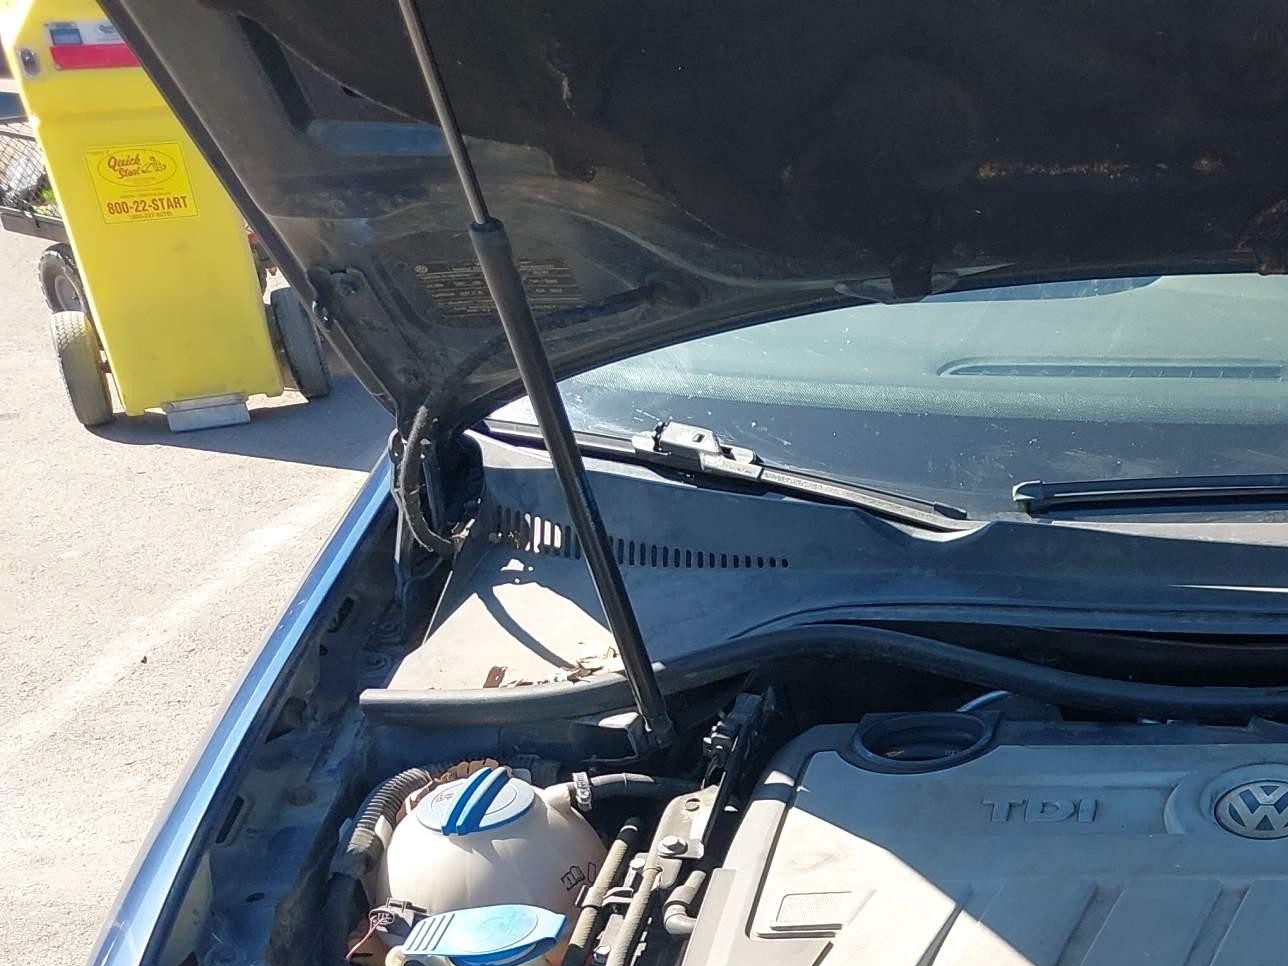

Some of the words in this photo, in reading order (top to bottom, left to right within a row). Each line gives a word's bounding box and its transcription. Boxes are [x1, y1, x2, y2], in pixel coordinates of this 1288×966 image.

[107, 153, 142, 172] Quick
[117, 166, 141, 180] Start
[107, 196, 188, 215] 800-22-START
[982, 799, 1098, 823] TDI
